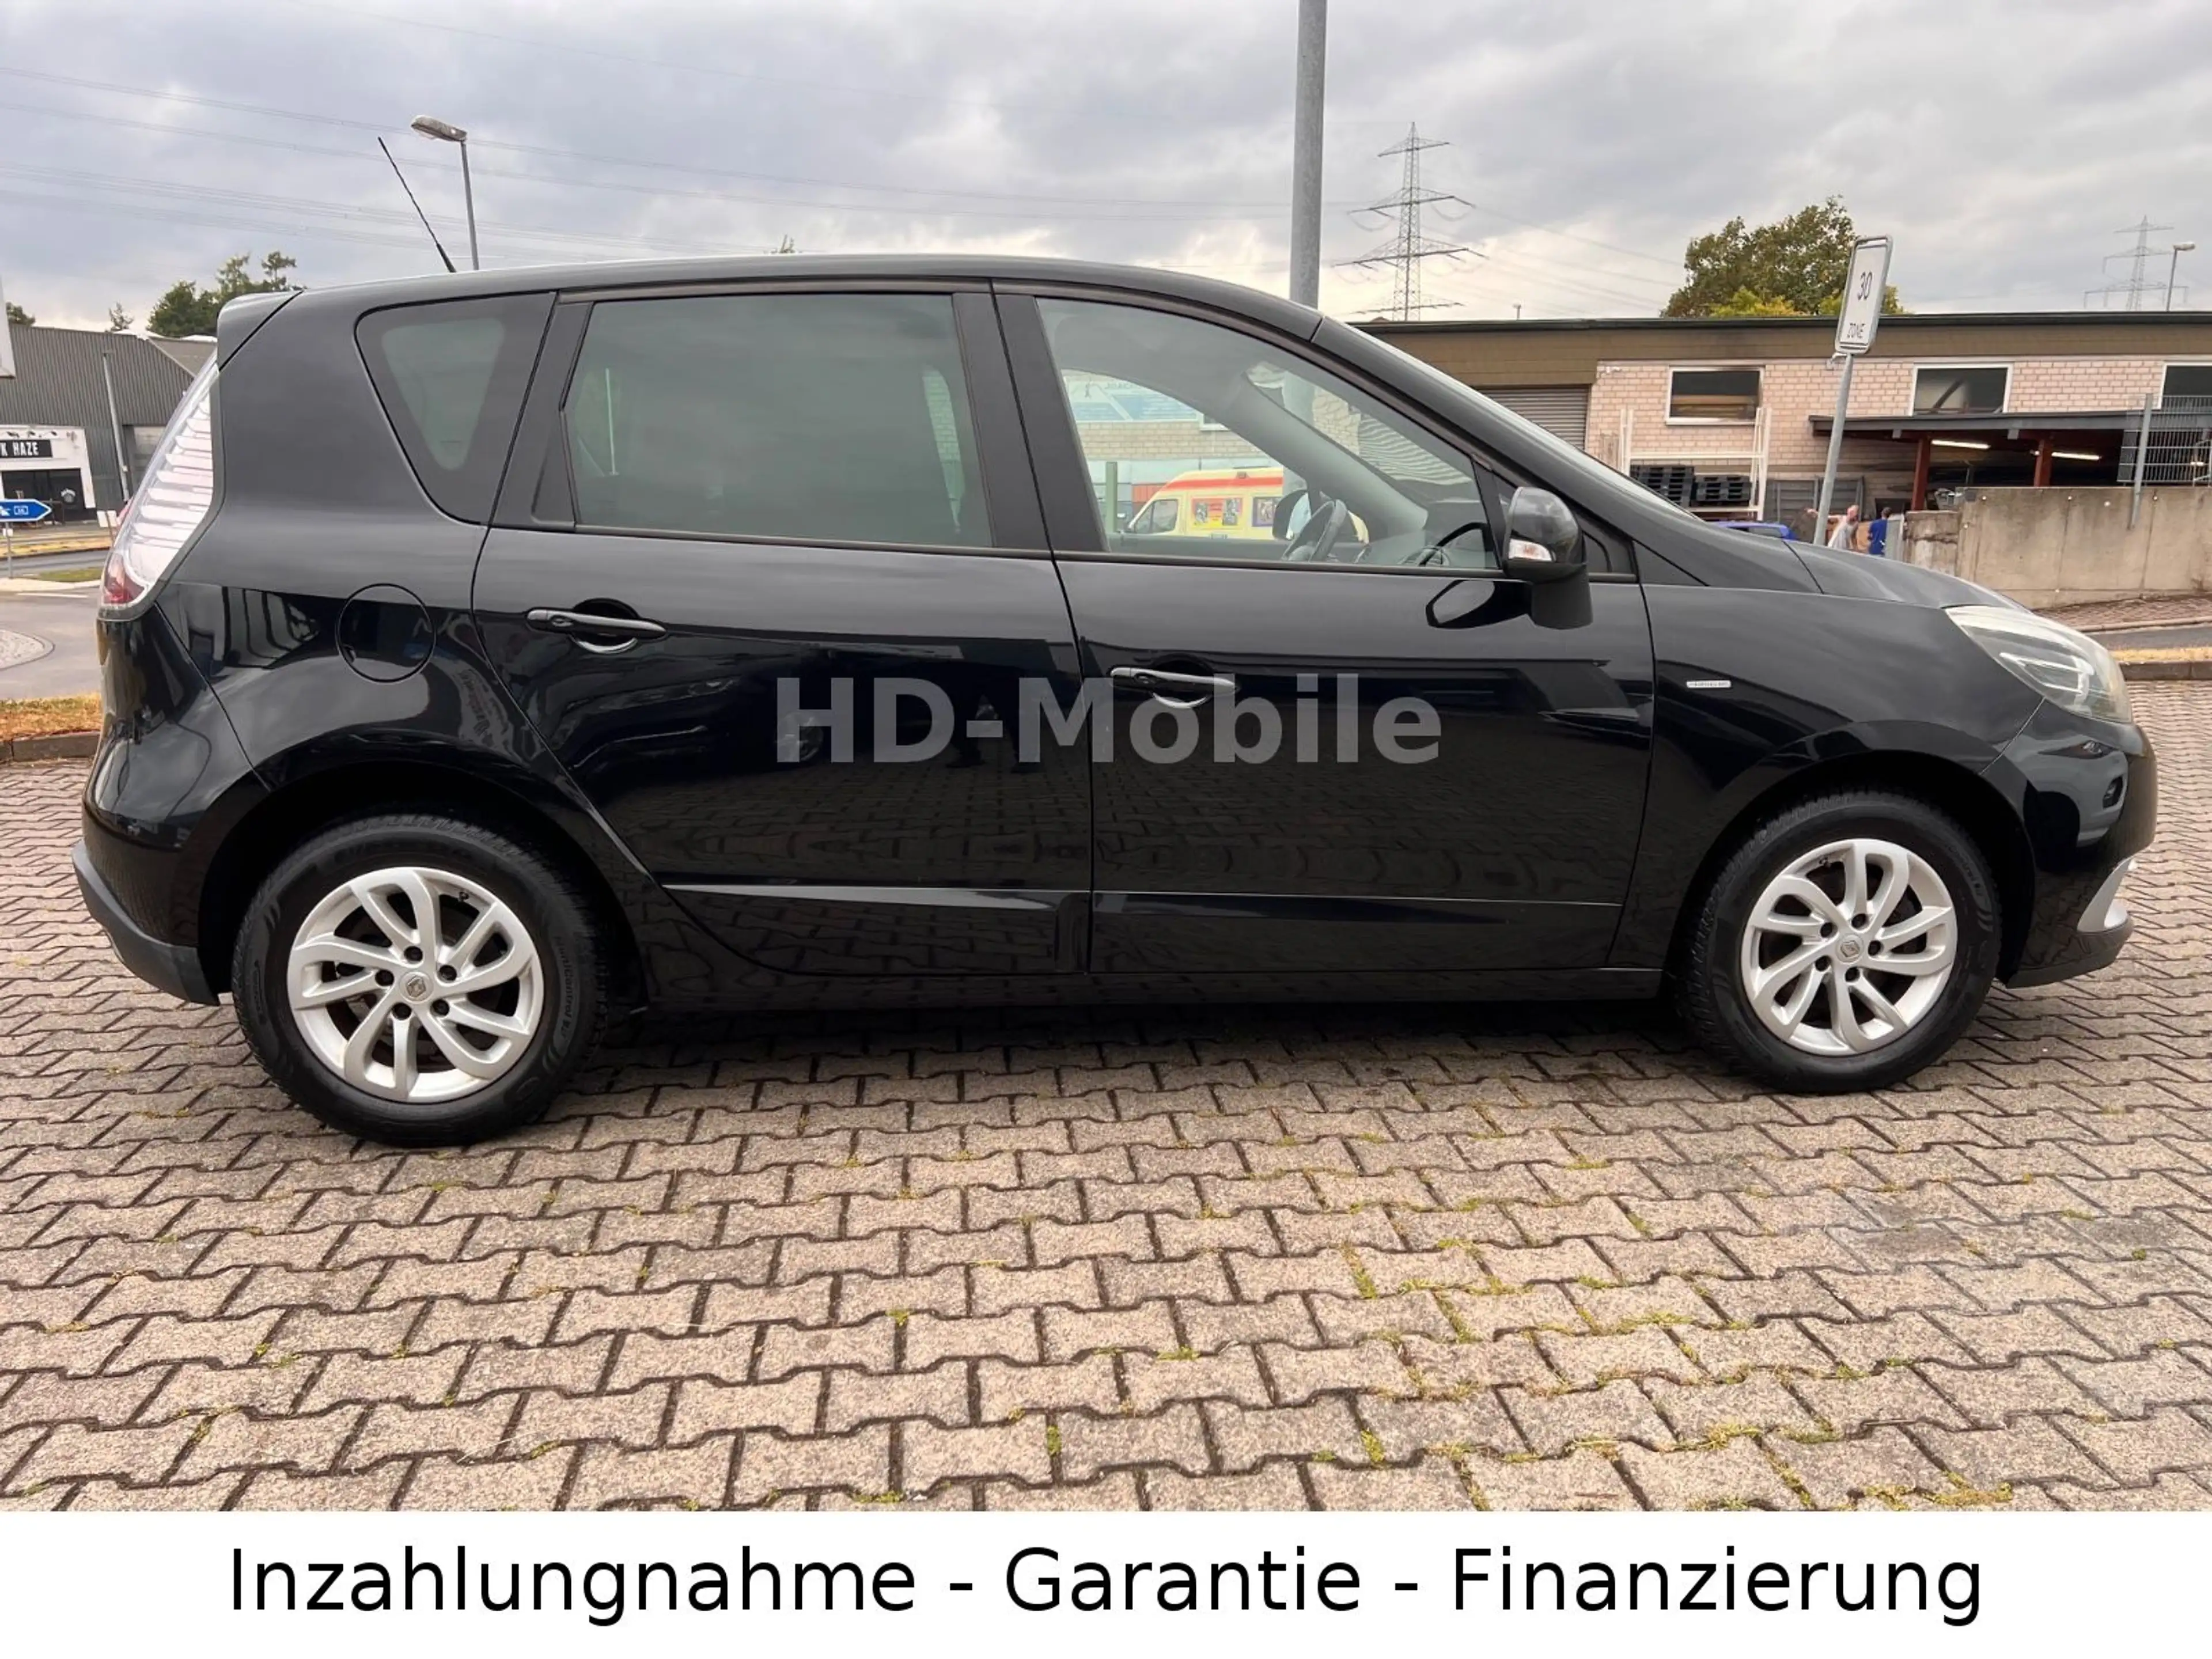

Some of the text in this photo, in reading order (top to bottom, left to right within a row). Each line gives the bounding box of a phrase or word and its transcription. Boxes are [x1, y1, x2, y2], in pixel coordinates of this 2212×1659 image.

[1857, 271, 1873, 301] 30
[1847, 323, 1866, 339] ZONE
[12, 442, 39, 456] HAZE
